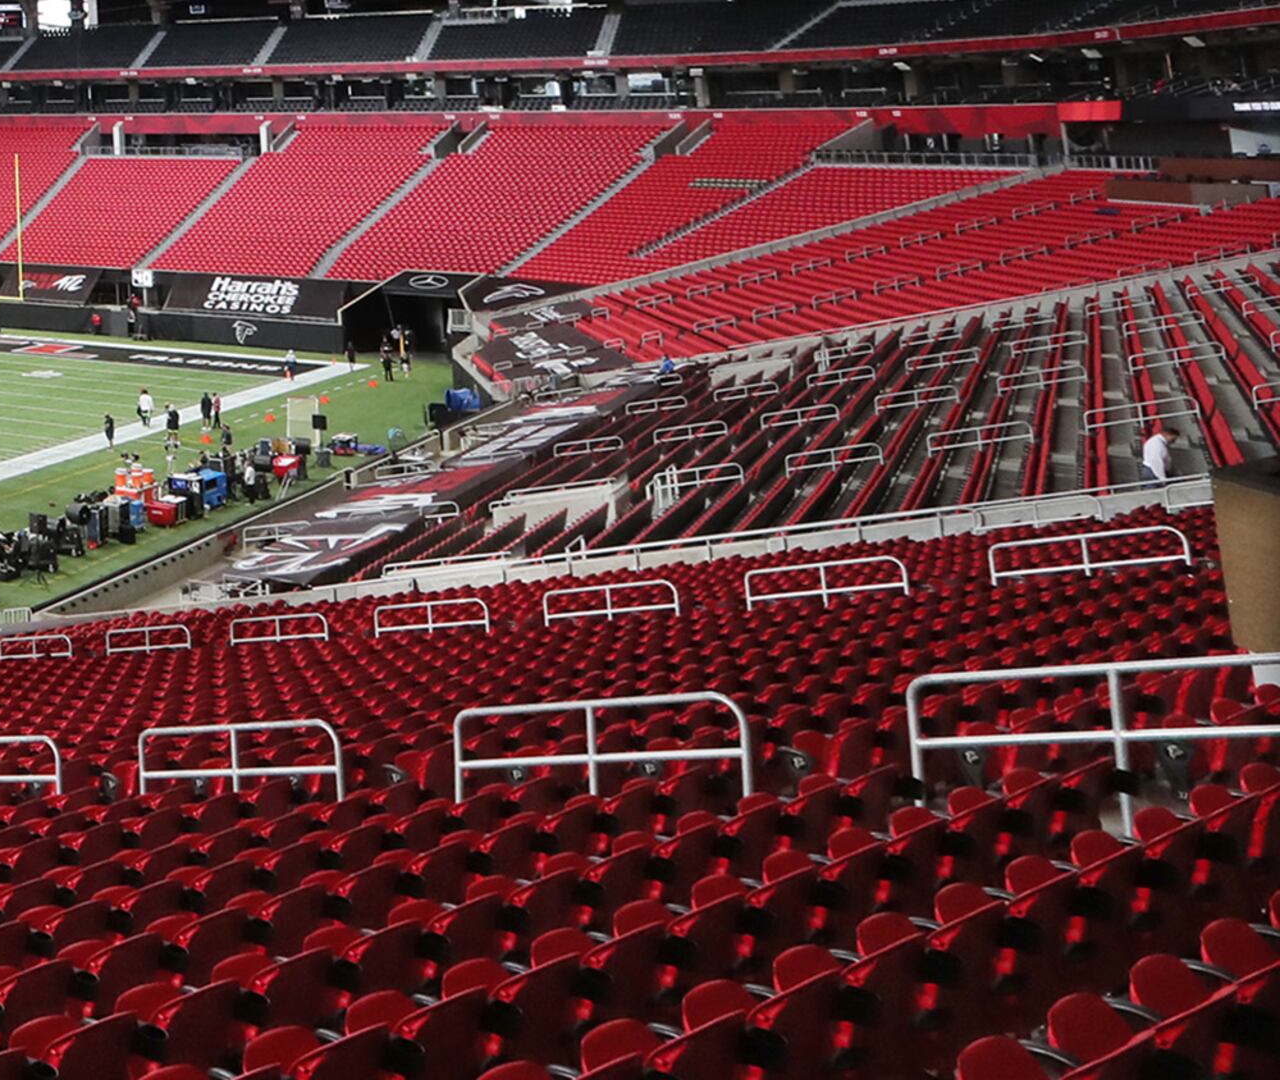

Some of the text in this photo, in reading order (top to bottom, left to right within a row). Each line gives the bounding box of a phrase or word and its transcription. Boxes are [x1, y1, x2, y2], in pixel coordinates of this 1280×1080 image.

[210, 277, 299, 296] Harrah's
[207, 291, 296, 306] CHEROKEE
[203, 300, 291, 314] CASINOS
